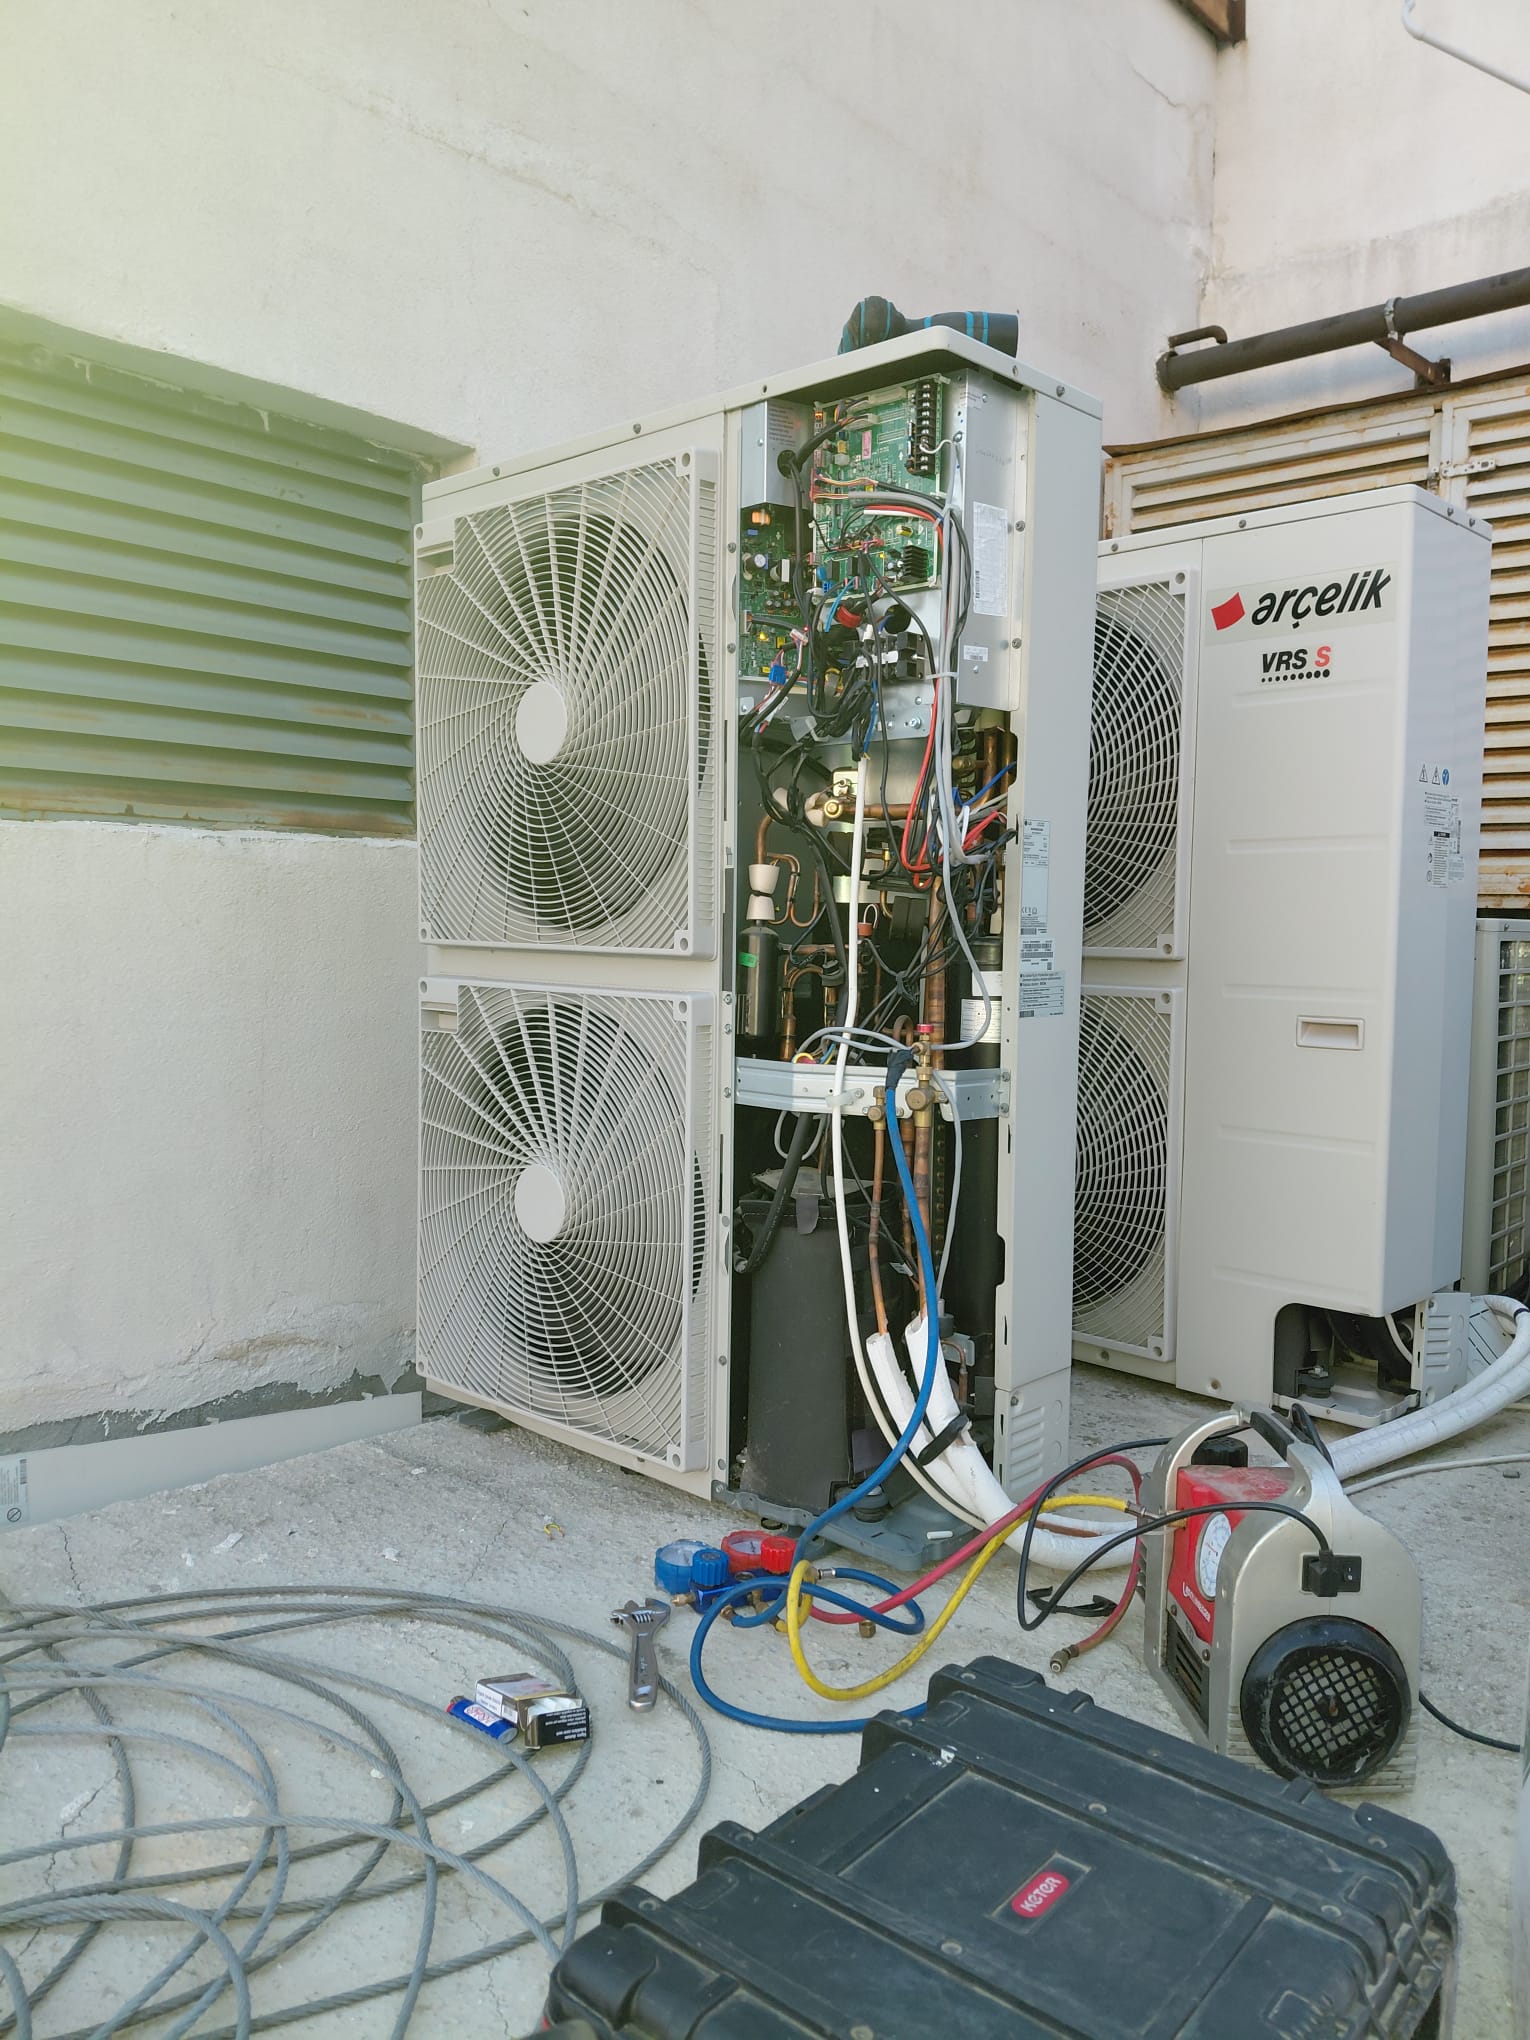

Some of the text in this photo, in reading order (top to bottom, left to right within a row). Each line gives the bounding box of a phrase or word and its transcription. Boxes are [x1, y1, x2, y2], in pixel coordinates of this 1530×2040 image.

[1251, 568, 1392, 629] arçelik
[1262, 645, 1332, 673] VRS S
